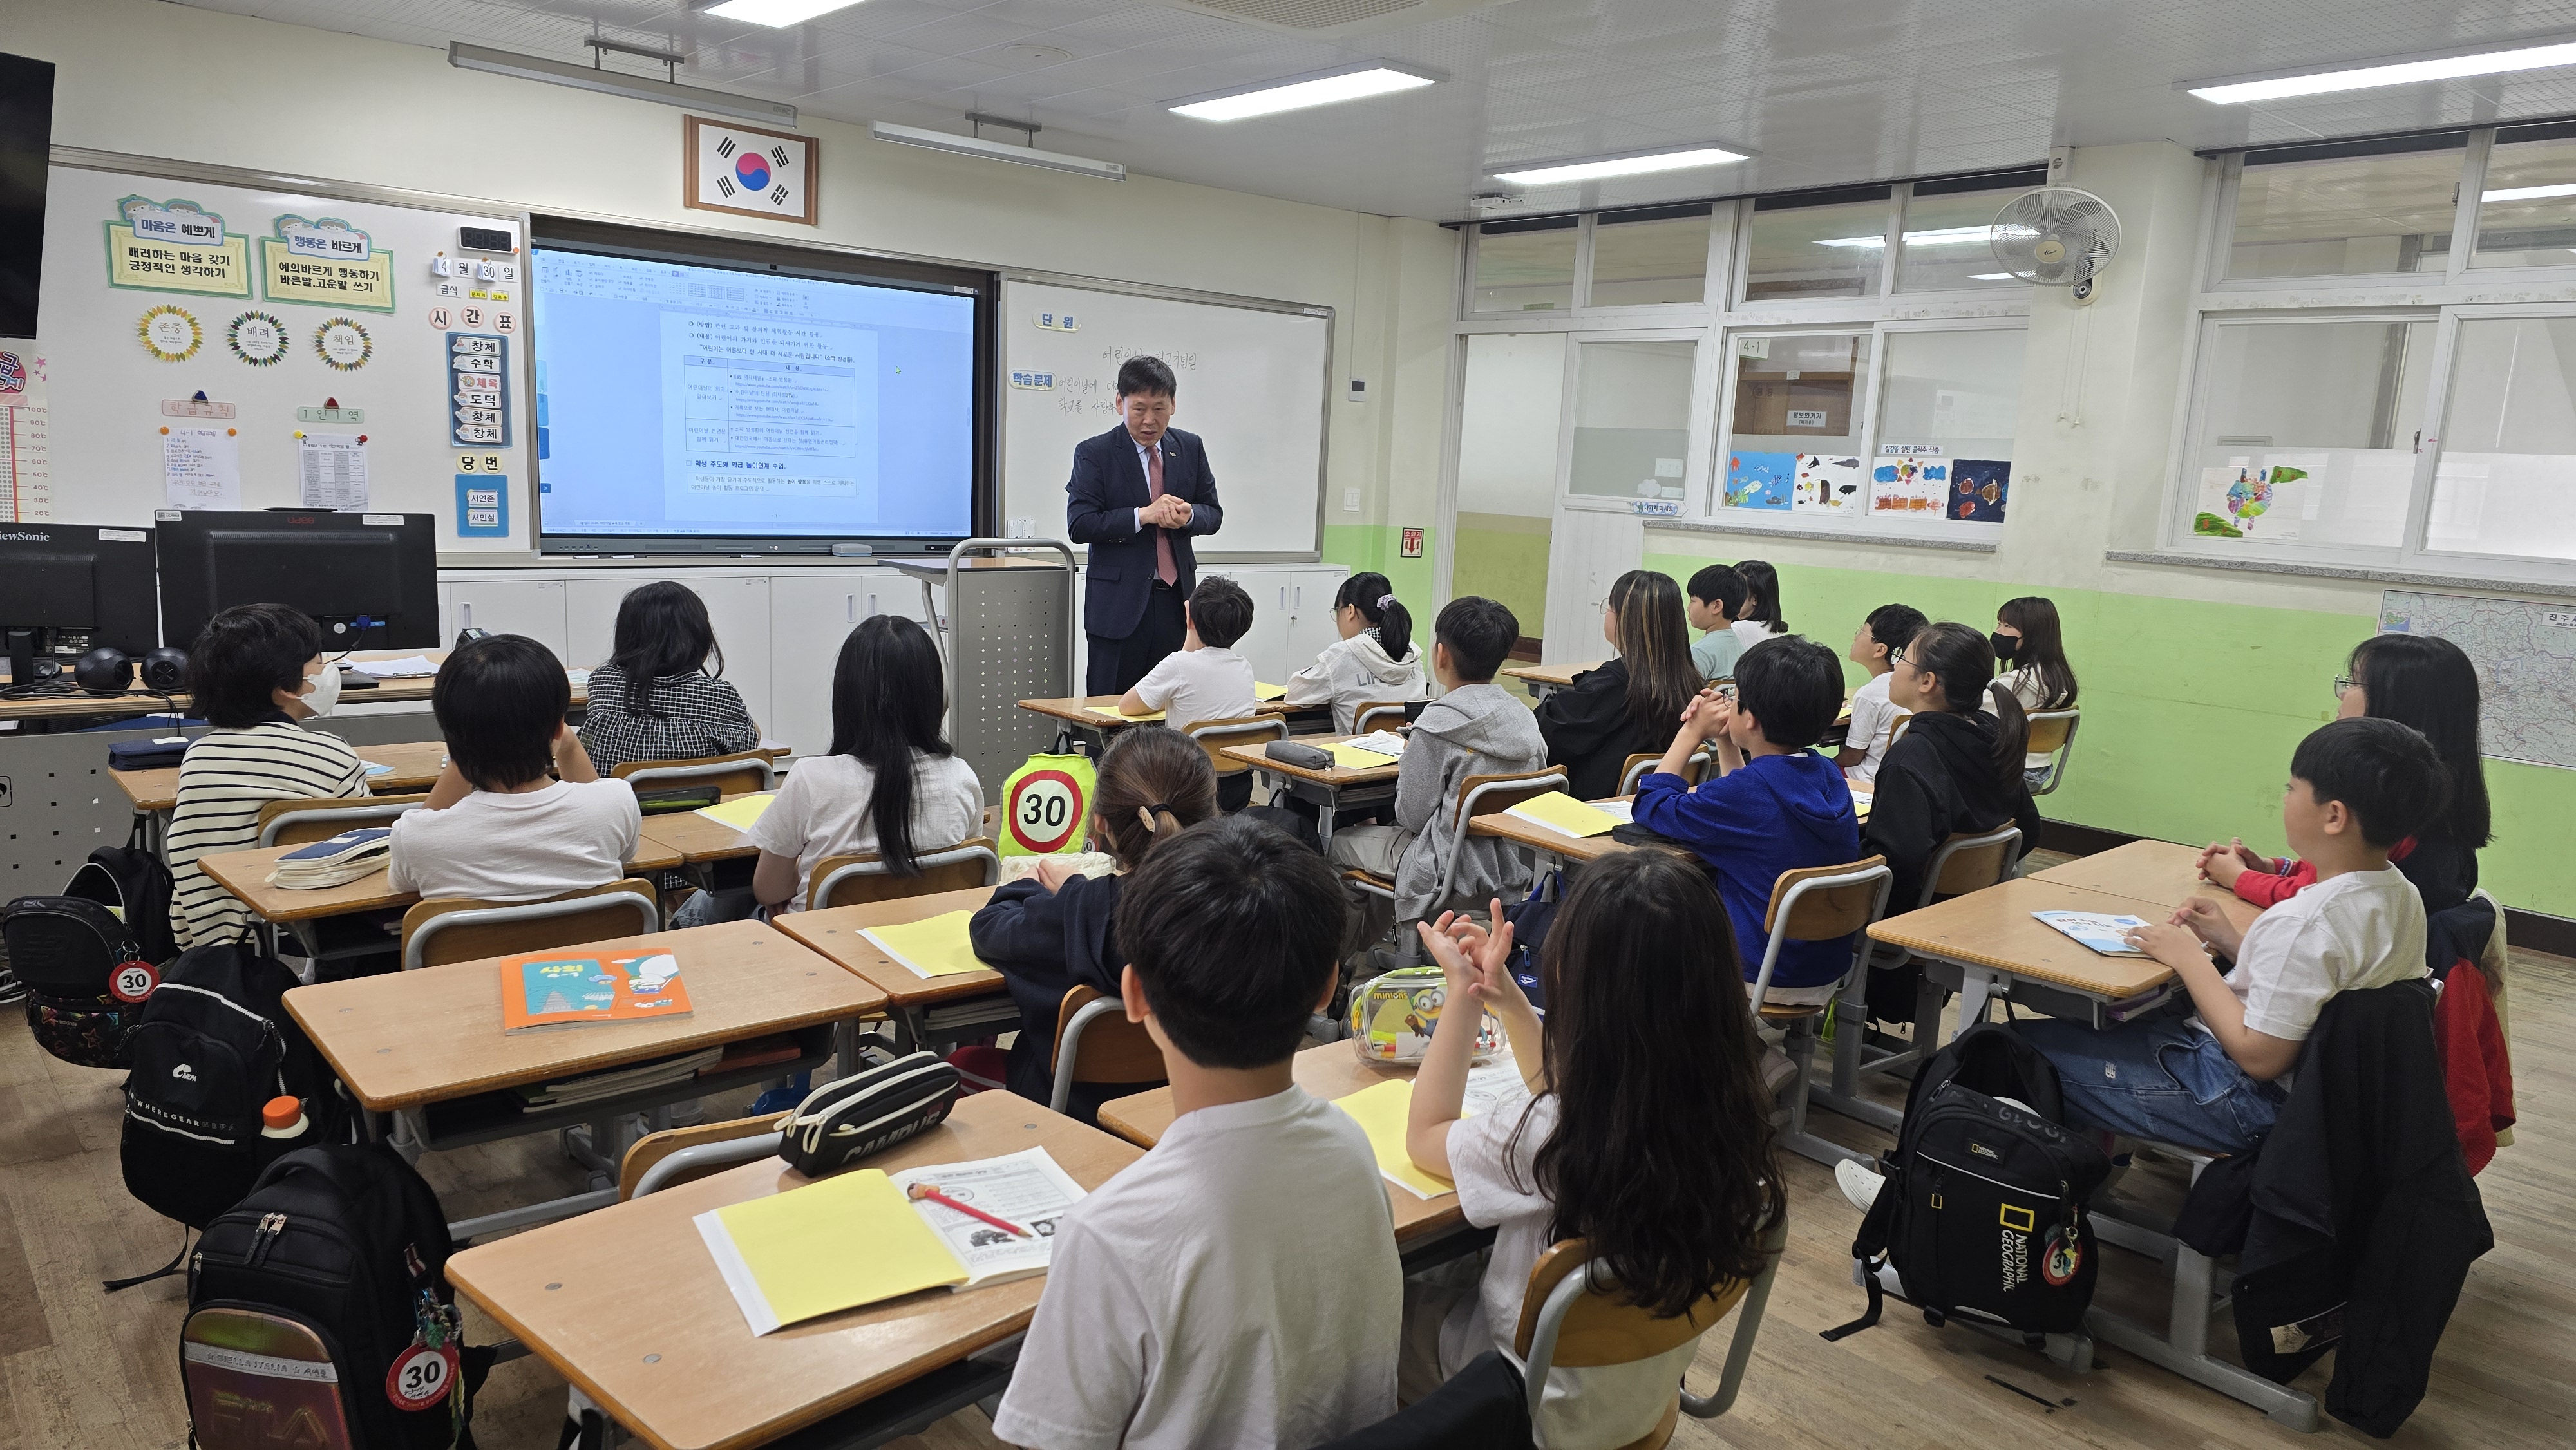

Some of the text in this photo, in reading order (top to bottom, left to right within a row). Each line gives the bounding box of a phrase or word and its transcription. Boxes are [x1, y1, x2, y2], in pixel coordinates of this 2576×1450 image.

[141, 219, 215, 238] 마음은 예쁘게
[294, 236, 363, 254] 행동은 바르게
[128, 247, 231, 266] 배려하는 마음 갖기
[129, 260, 226, 279] 긍정적인 생각하기
[279, 261, 379, 281] 예의바르게 행동하기
[442, 261, 513, 279] 4 월 30 일
[353, 283, 373, 292] 쓰기
[440, 284, 457, 296] 급식
[158, 322, 184, 334] 존중
[247, 326, 269, 338] 배려
[334, 334, 354, 345] 책임
[471, 341, 495, 353] 창체
[1744, 340, 1759, 353] 4-1
[470, 359, 493, 369] 수학
[477, 378, 498, 389] 체육
[1059, 377, 1097, 395] 어린이날에
[470, 395, 495, 406] 도덕
[1058, 397, 1083, 417] 학교를
[472, 411, 496, 423] 창체
[473, 428, 497, 439] 창체
[1024, 794, 1066, 827] 30
[122, 974, 147, 989] 30
[182, 1073, 197, 1082] NEPA
[2002, 1229, 2015, 1292] GEOGRAPHIC
[2016, 1234, 2028, 1283] NATIONAL
[254, 1361, 287, 1372] ITALIA
[406, 1361, 440, 1389] 30
